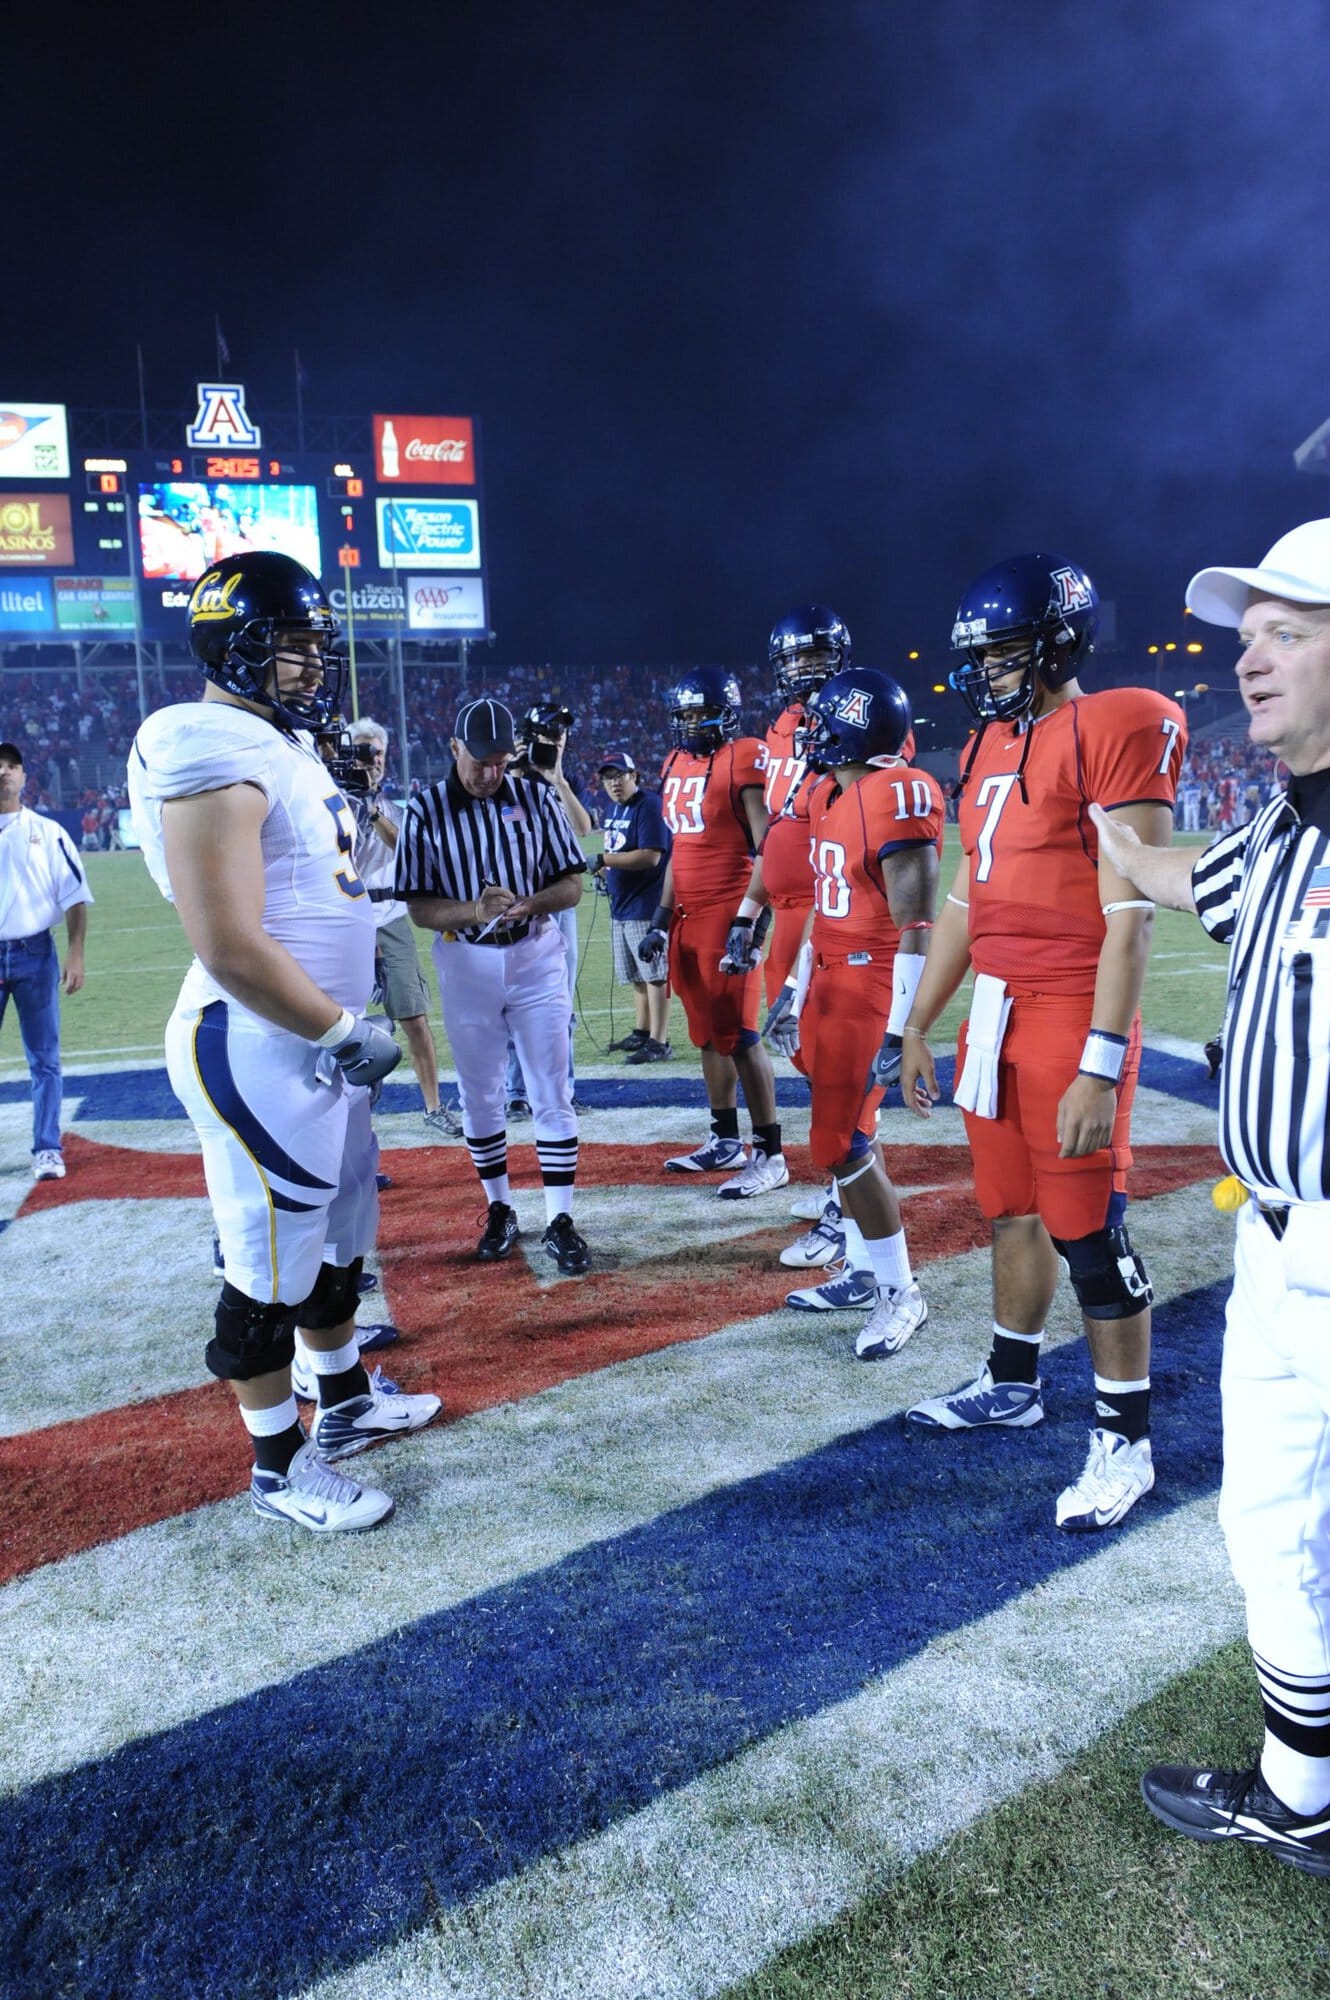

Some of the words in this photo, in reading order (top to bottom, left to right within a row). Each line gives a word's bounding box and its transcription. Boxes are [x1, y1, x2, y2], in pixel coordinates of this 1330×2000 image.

[186, 383, 261, 449] A
[207, 457, 260, 478] 2:05
[405, 508, 452, 523] Tucson
[411, 522, 465, 536] Electric
[416, 534, 465, 549] Power
[191, 571, 242, 624] Cal
[328, 586, 405, 609] Ctizen
[1050, 566, 1094, 617] A
[835, 688, 873, 729] A
[1161, 717, 1181, 775] 7
[663, 776, 706, 835] 33
[890, 779, 933, 821] 10
[975, 773, 1019, 883] 7
